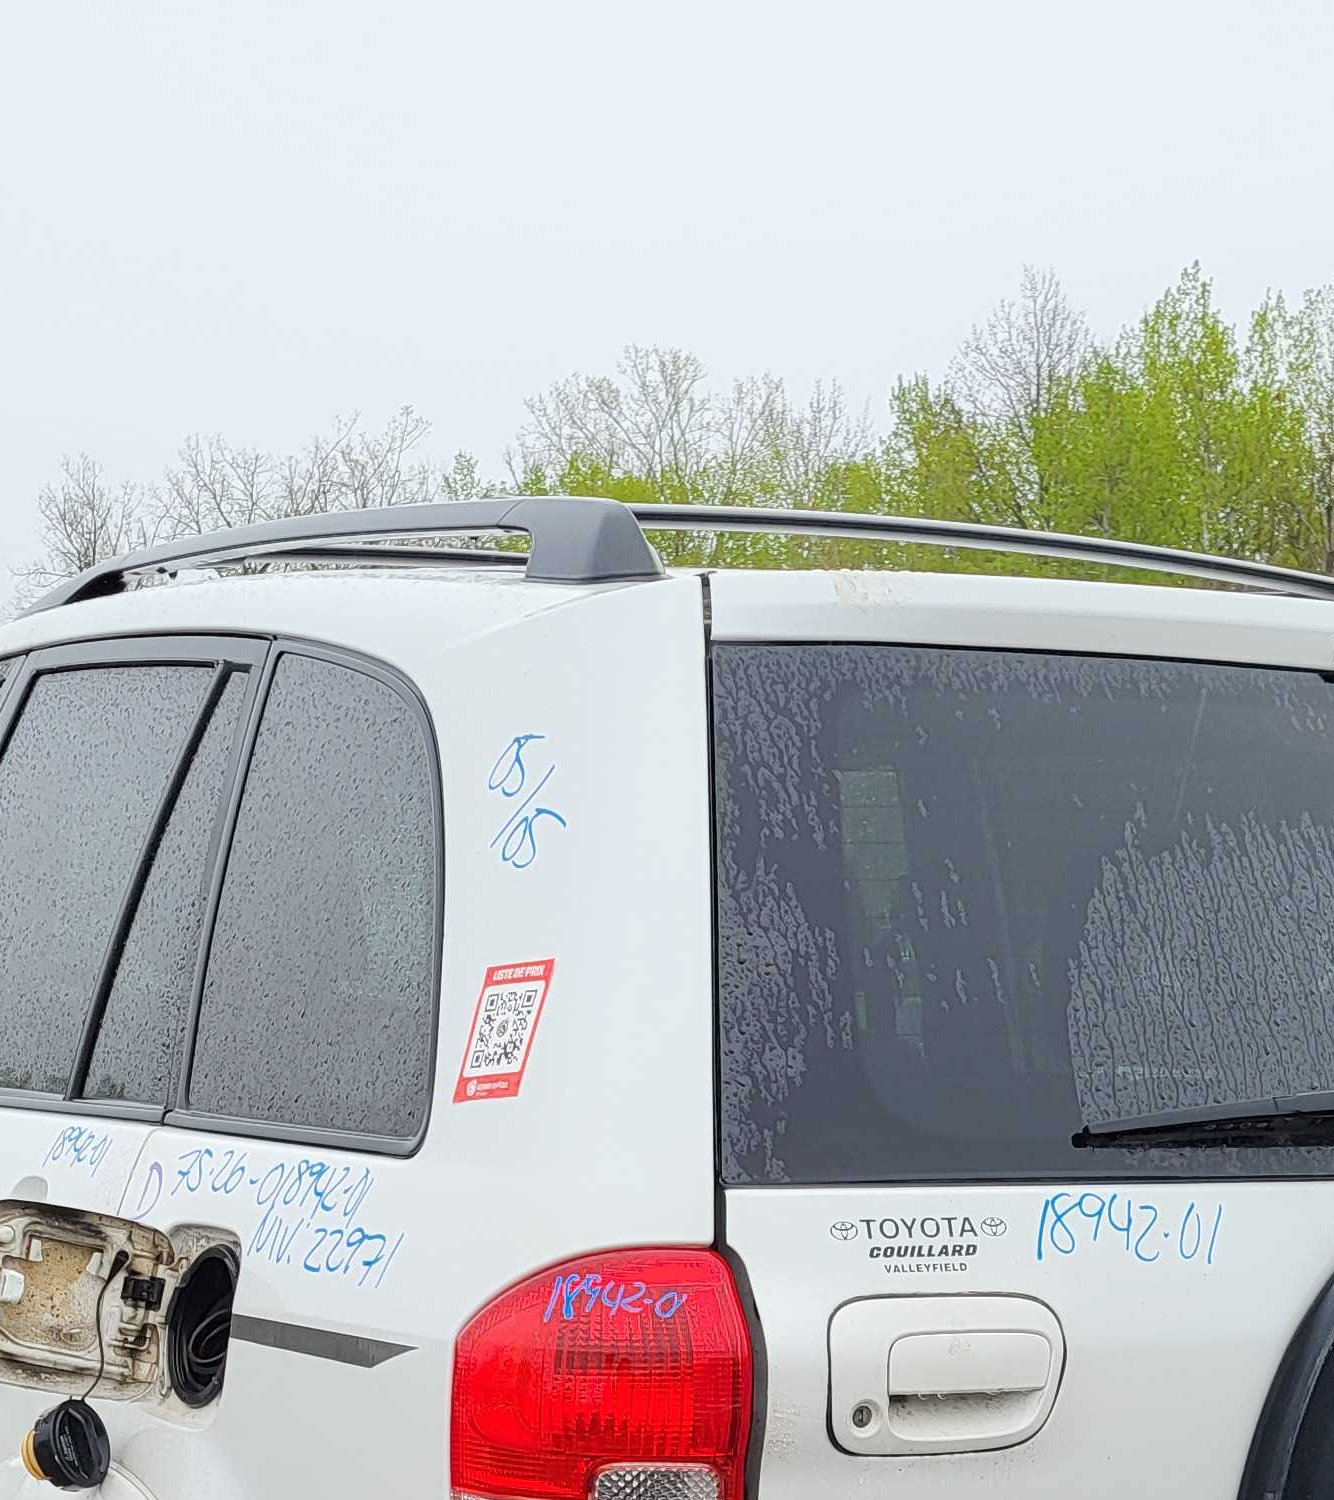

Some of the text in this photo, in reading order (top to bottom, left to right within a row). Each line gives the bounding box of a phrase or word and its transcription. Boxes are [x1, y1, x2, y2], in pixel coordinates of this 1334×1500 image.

[492, 964, 546, 981] LISTE DE PRIX
[859, 1216, 979, 1240] TOYOTA
[868, 1243, 979, 1259] COUILLARD
[883, 1262, 968, 1274] VALLEYFIELD
